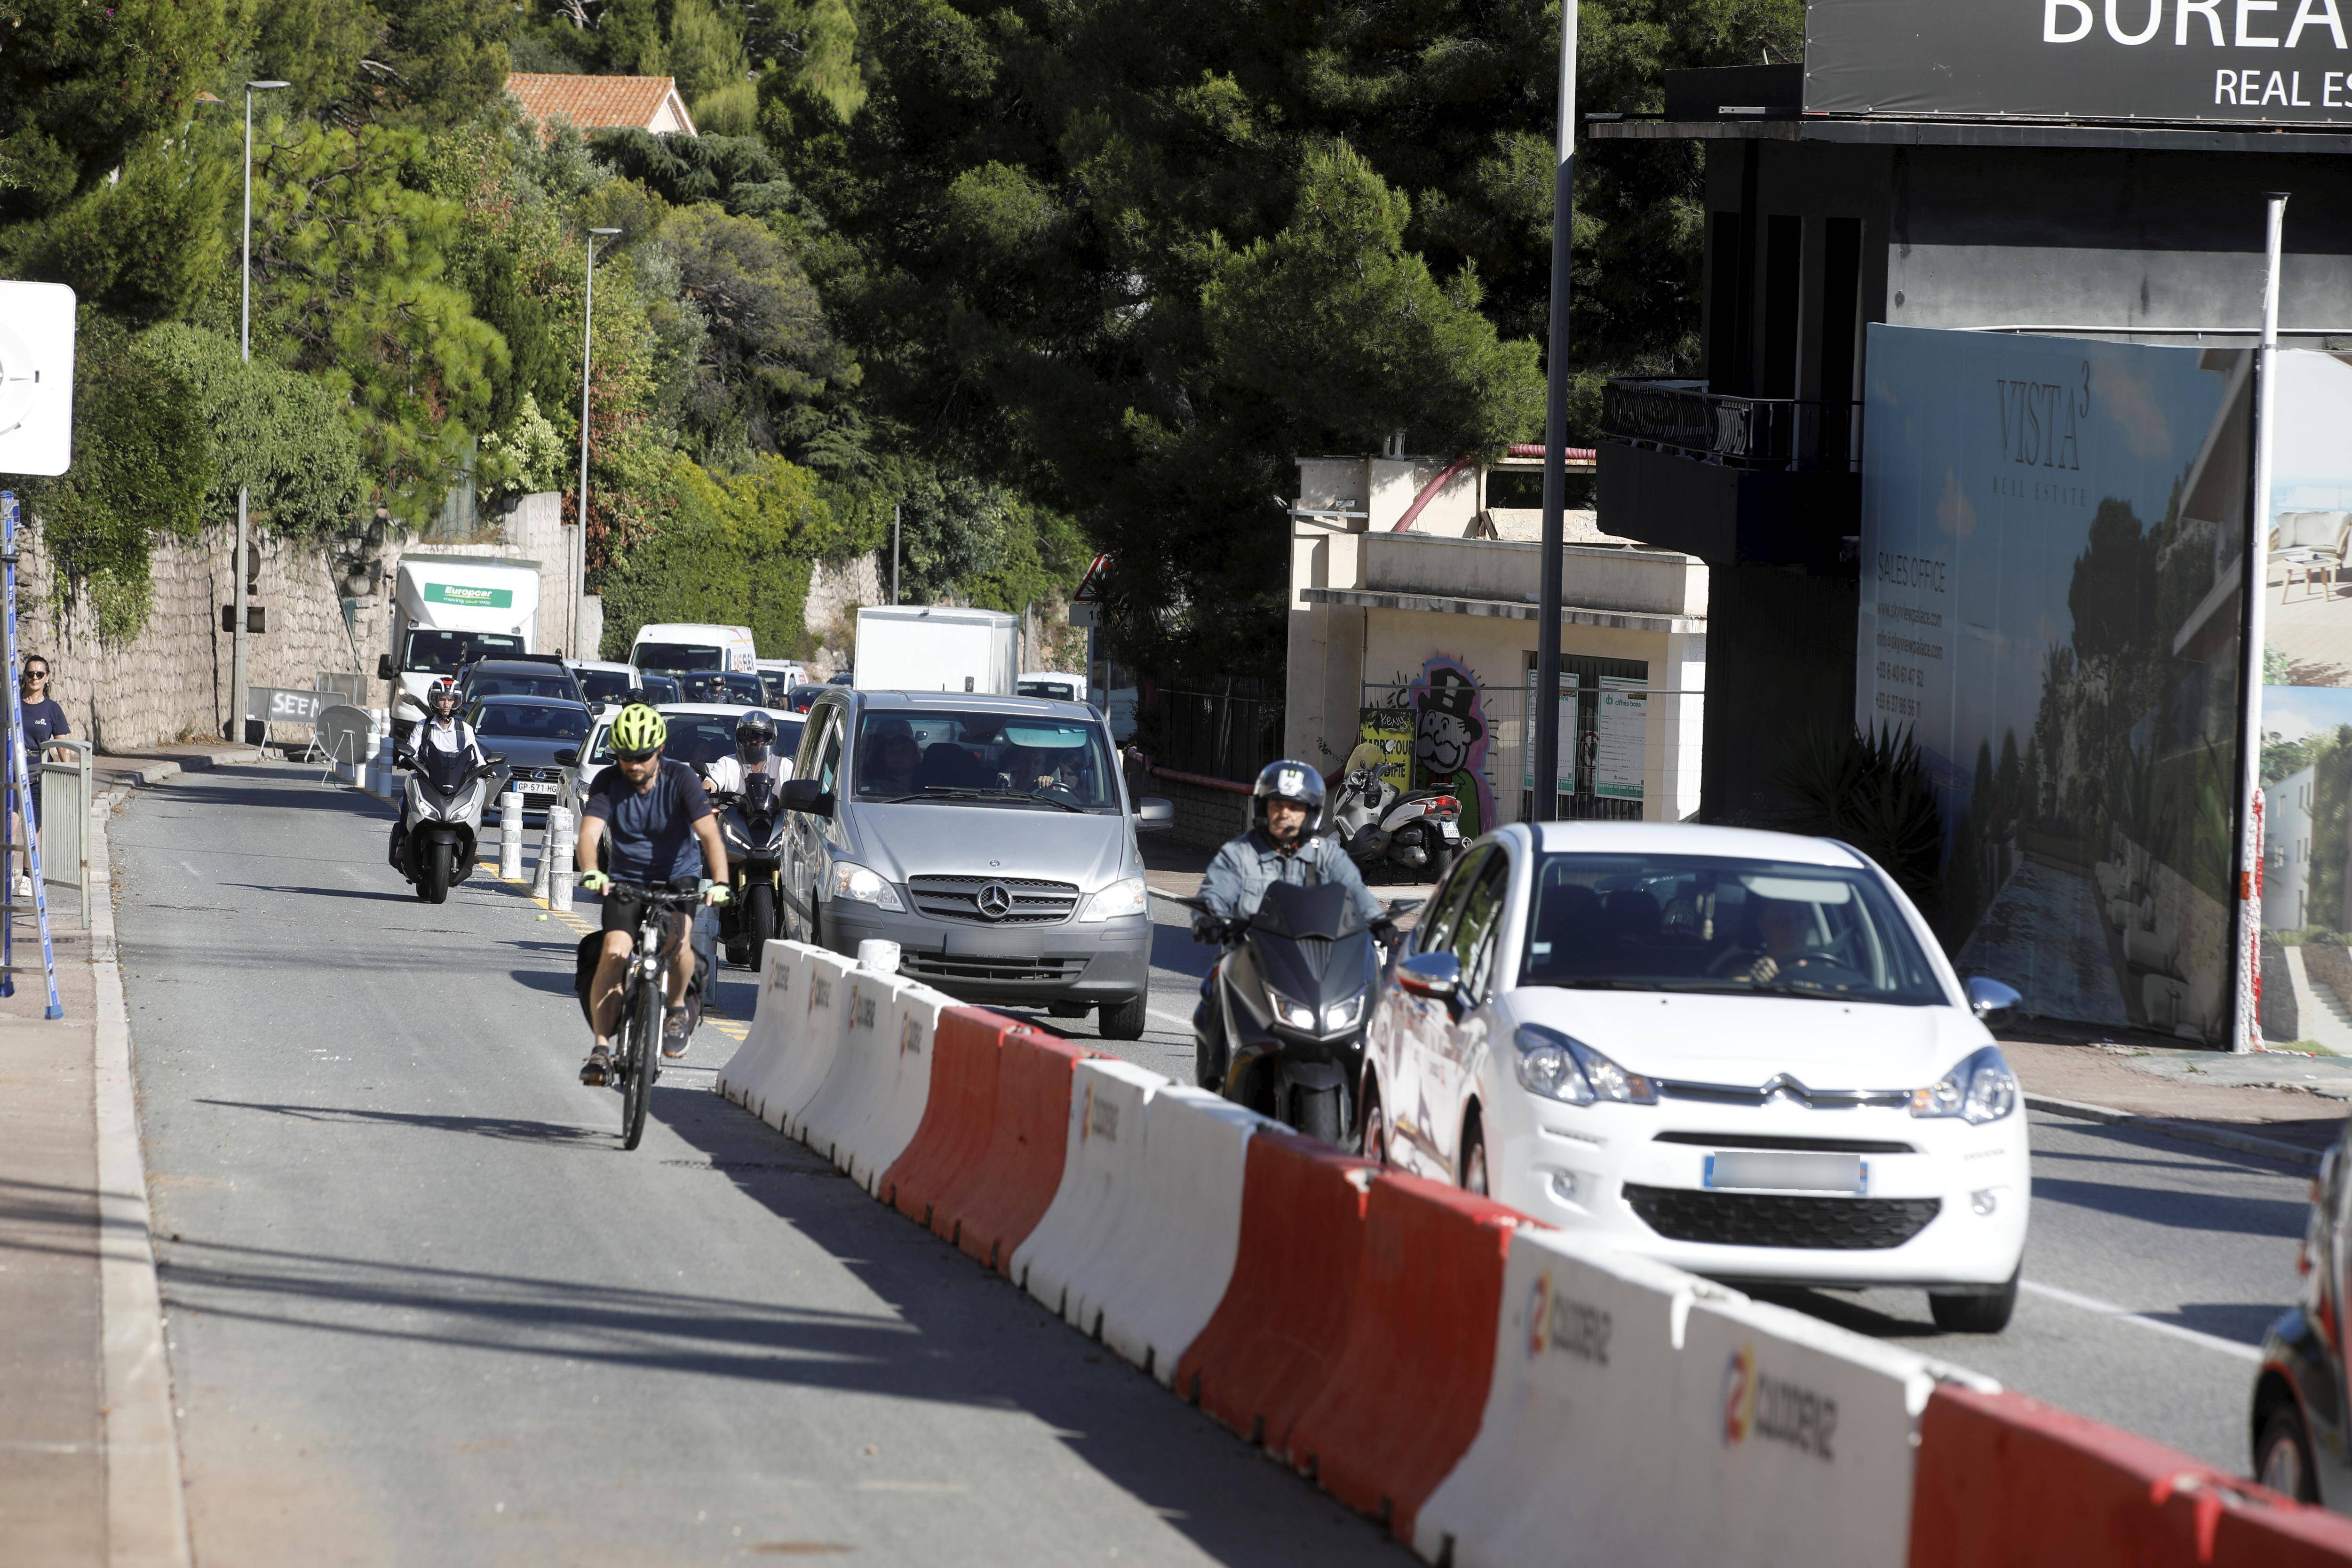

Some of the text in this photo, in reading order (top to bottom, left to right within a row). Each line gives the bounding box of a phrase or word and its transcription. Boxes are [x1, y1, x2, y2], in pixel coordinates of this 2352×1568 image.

[2215, 69, 2311, 106] REAL
[1994, 477, 2086, 507] REAL ESTATE
[1878, 551, 1946, 593] SALES OFFICE
[445, 586, 493, 598] Europcar
[1877, 601, 1942, 629] www.skyviewpalace.com
[1876, 661, 1886, 679] +33
[1887, 663, 1891, 680] 6
[1892, 664, 1900, 682] 40
[1908, 668, 1915, 685] 47
[1876, 692, 1885, 709] +33
[1886, 694, 1891, 711] 6
[518, 783, 556, 793] GP-571-HG
